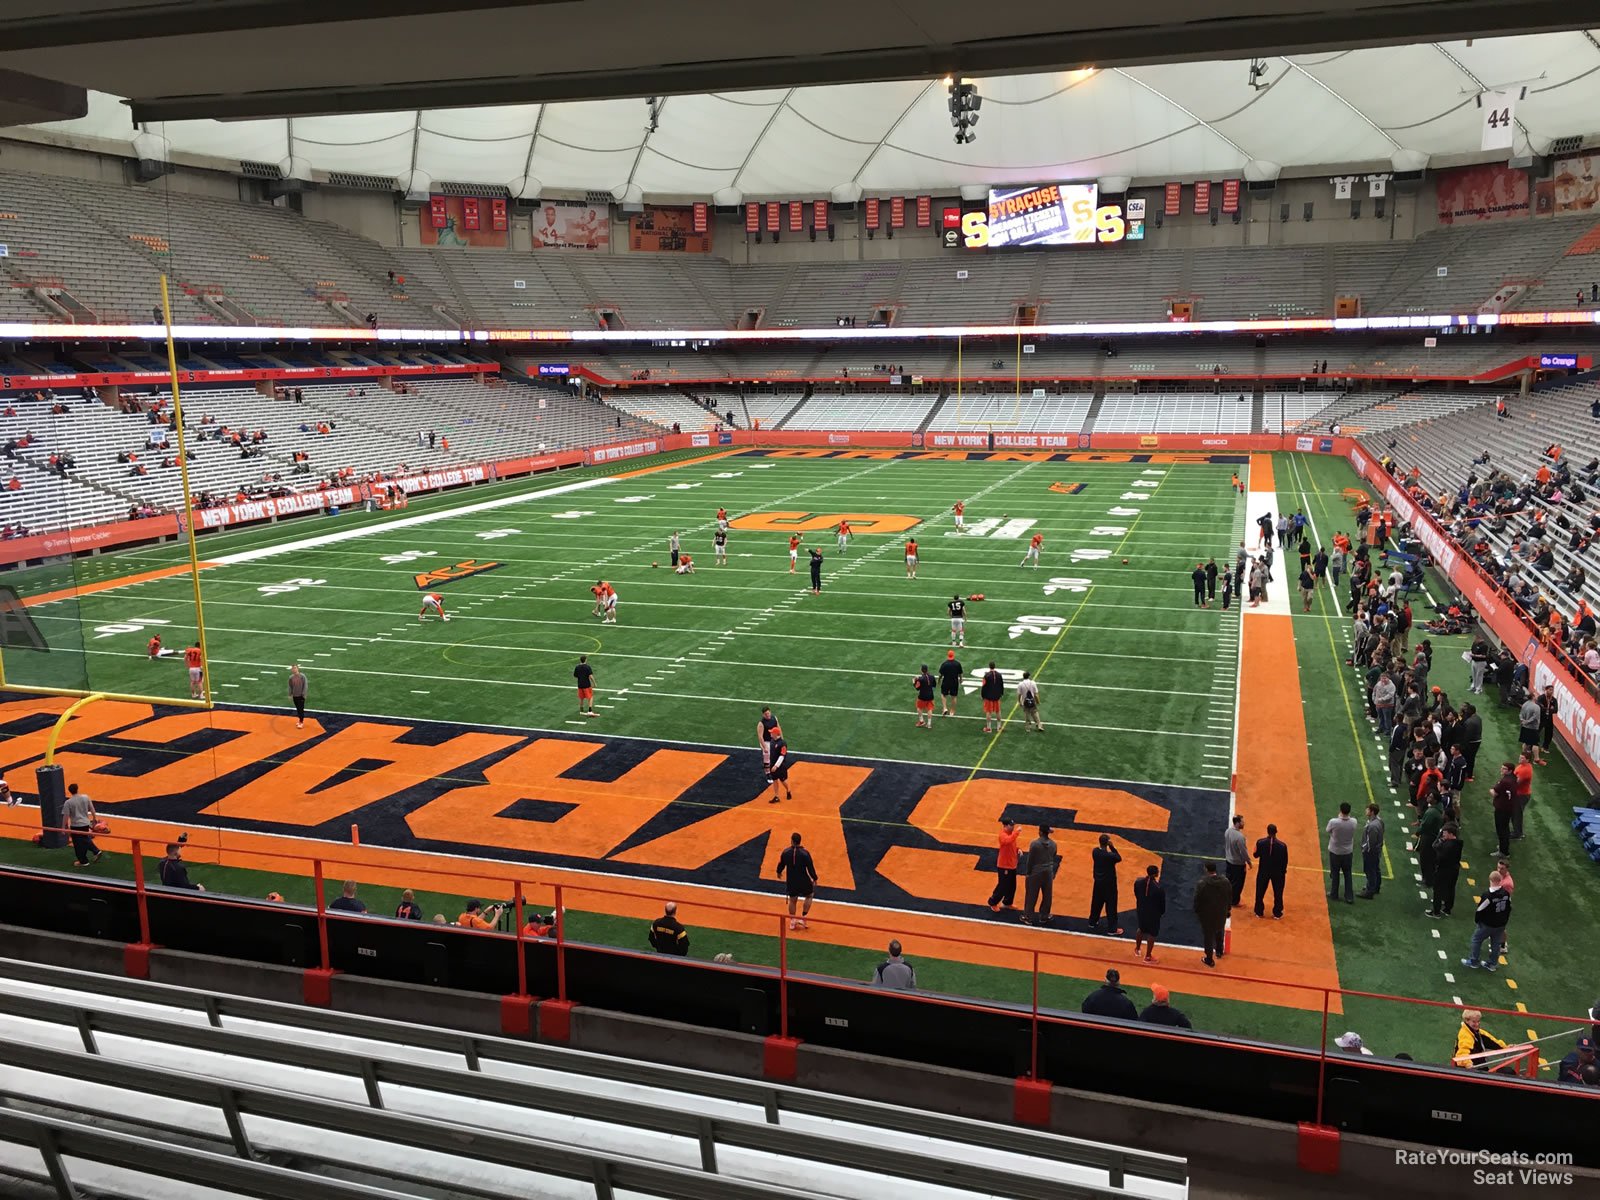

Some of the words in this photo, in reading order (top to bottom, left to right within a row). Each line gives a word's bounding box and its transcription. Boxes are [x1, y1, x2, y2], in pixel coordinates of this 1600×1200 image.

[1488, 108, 1510, 128] 44
[1340, 185, 1346, 193] 5
[990, 186, 1059, 219] SYRACUSE
[1455, 208, 1487, 217] NATIONAL
[1488, 203, 1530, 213] CHAMPIONS
[1499, 313, 1546, 324] SYRACUSE
[490, 331, 530, 340] SYRACUSE
[1541, 357, 1551, 366] Go
[1552, 357, 1576, 367] Orange
[549, 366, 569, 374] Orange
[934, 435, 956, 446] NEW
[958, 435, 990, 446] YORK'S
[994, 435, 1039, 446] COLLEGE
[1040, 436, 1068, 446] TEAM
[594, 450, 606, 462] NEW
[624, 444, 644, 458] COLLEGE
[644, 441, 657, 454] TEAM
[429, 470, 462, 488] COLLEGE
[464, 466, 484, 481] TEAM
[201, 508, 229, 527] NEW
[230, 500, 275, 521] YORK'S
[277, 493, 325, 513] COLLEGE
[325, 487, 353, 505] TEAM
[53, 538, 69, 547] Time
[70, 535, 91, 544] Warner
[415, 559, 501, 590] ACC
[951, 602, 961, 610] 15
[1553, 678, 1586, 744] YORK'S
